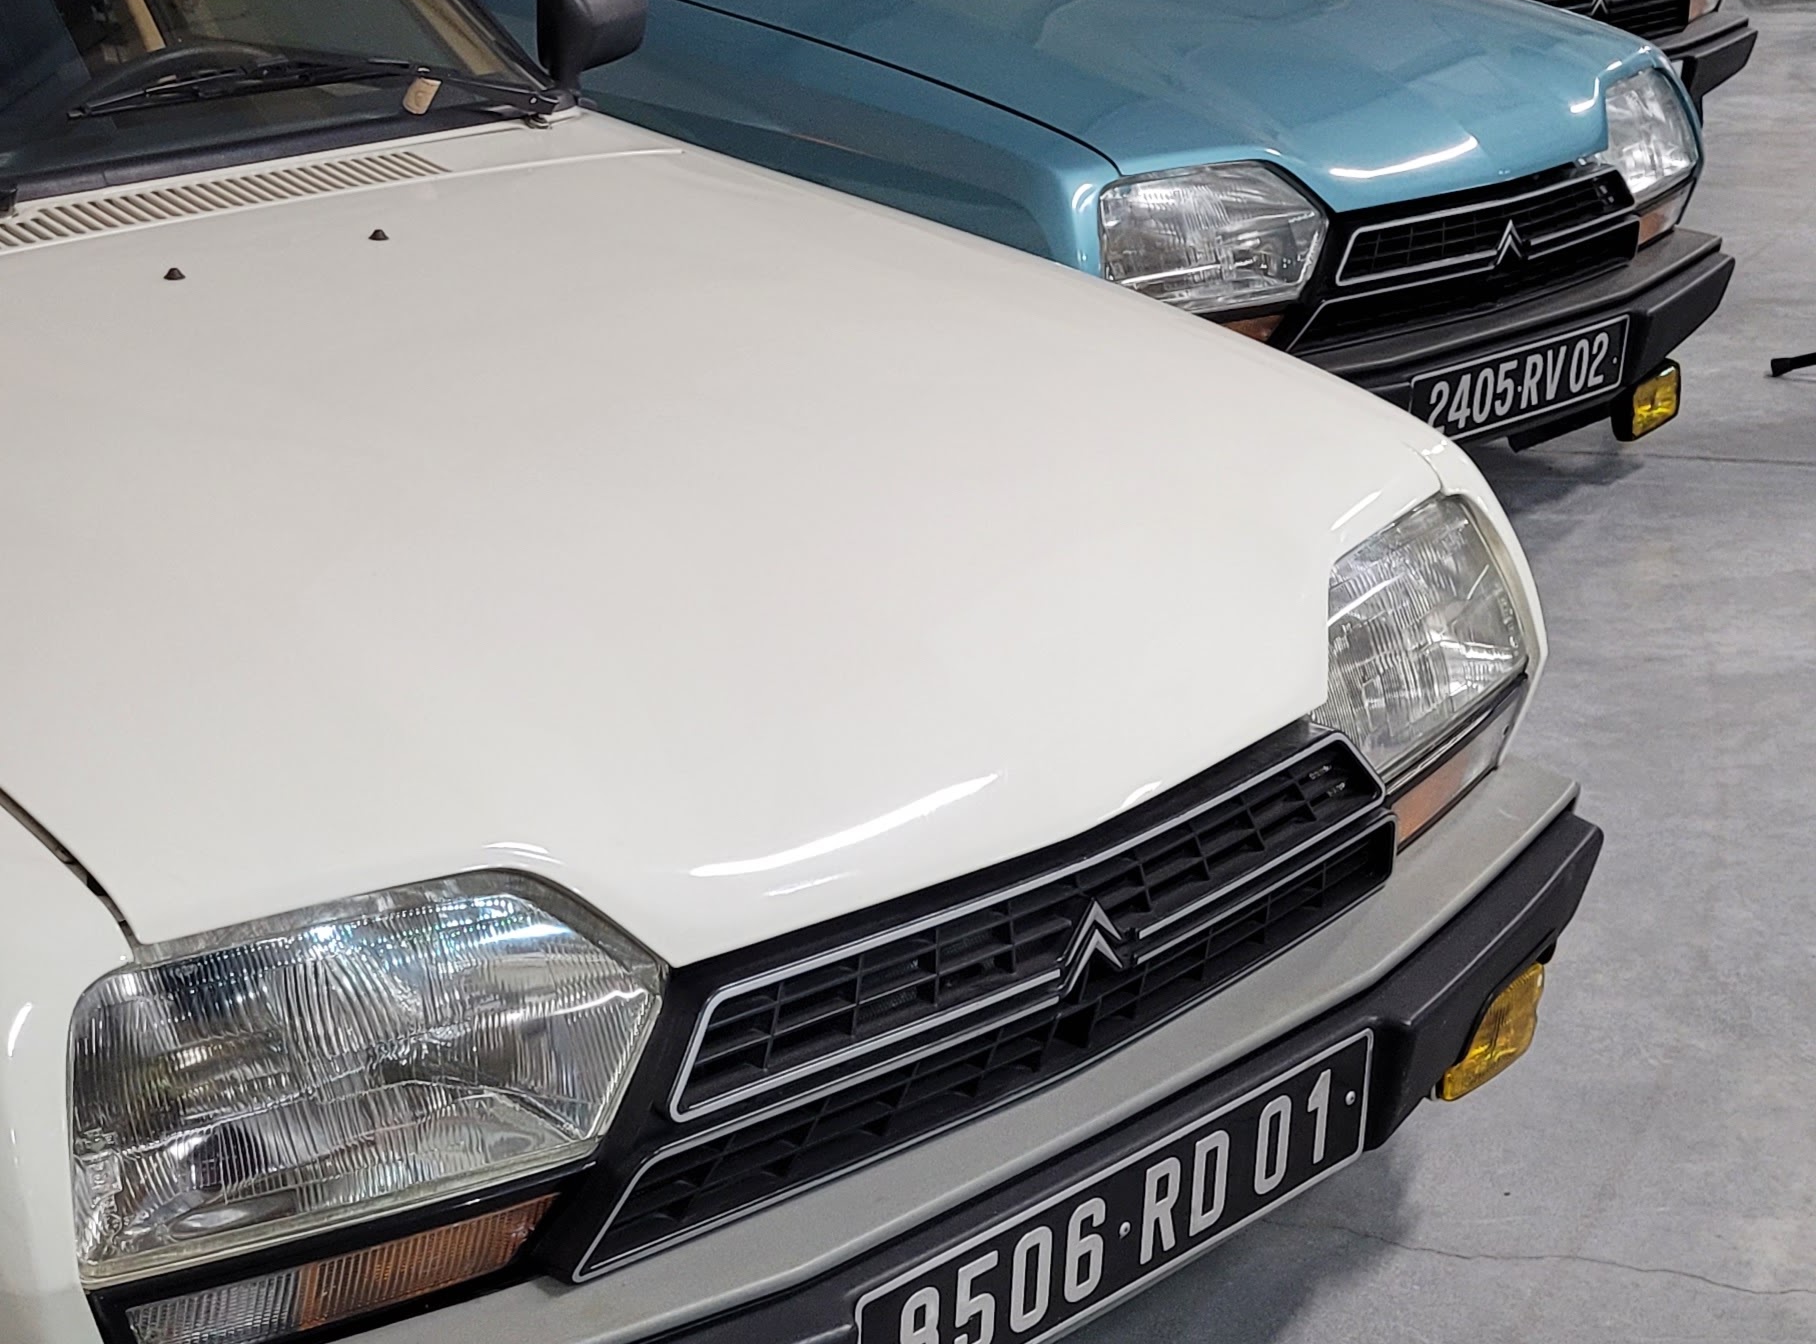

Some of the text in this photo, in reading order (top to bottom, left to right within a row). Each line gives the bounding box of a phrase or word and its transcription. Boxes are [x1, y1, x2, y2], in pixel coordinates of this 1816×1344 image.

[1428, 332, 1609, 433] 2405 RV 02
[1139, 1130, 1230, 1265] RD
[1253, 1069, 1332, 1196] 01
